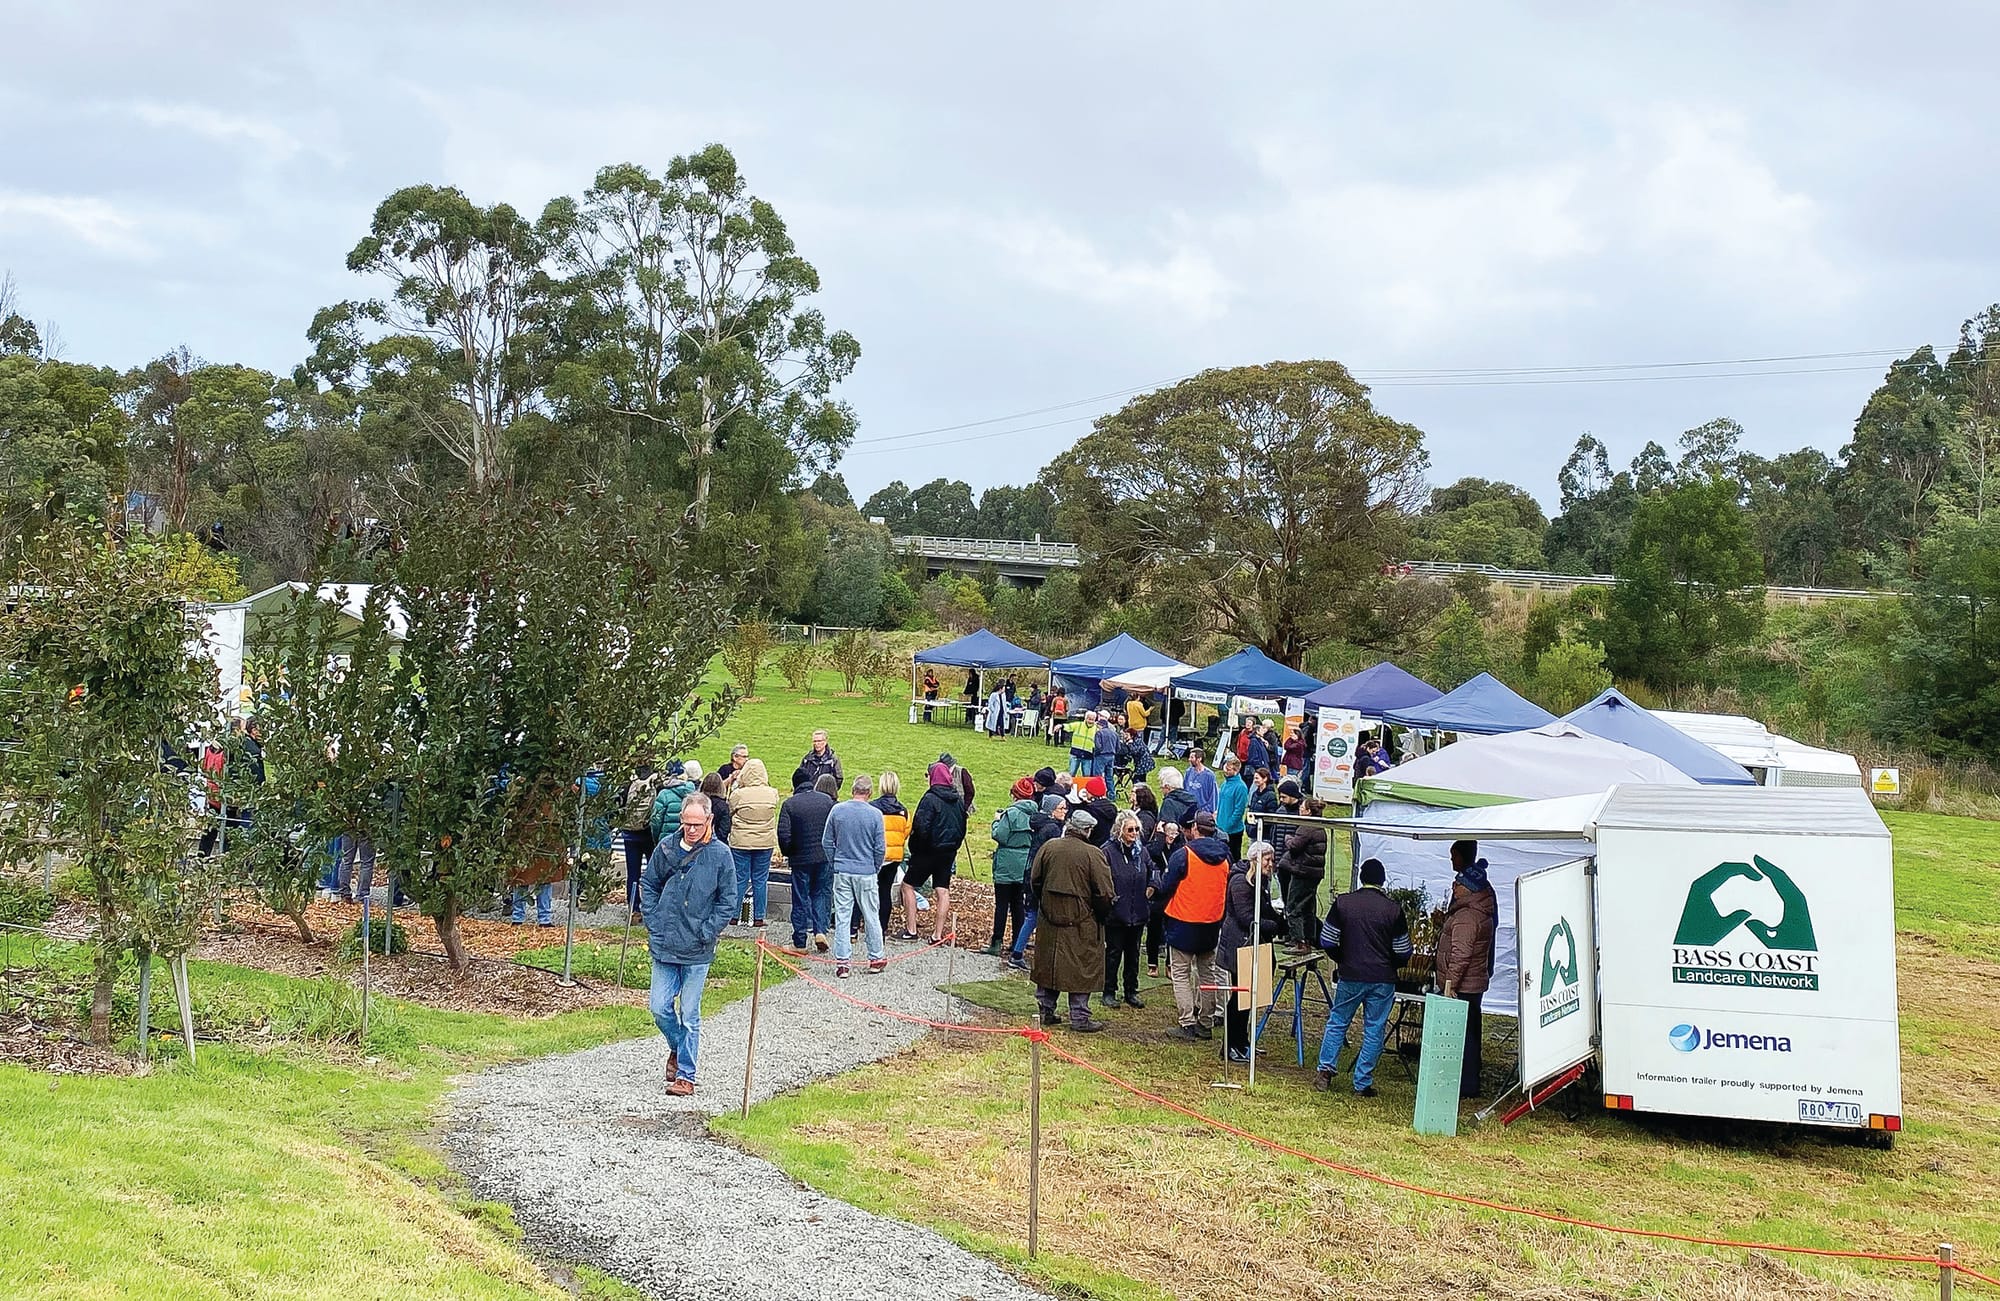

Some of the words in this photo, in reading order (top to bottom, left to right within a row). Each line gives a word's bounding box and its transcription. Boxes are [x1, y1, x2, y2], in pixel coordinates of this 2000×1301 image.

[1672, 948, 1732, 968] BASS
[1739, 951, 1819, 972] COAST
[1676, 968, 1746, 984] Landcare
[1751, 973, 1814, 988] Network
[1703, 1028, 1791, 1052] Jemena
[1636, 1072, 1688, 1083] Information
[1691, 1076, 1717, 1085] trailer
[1720, 1079, 1755, 1090] proudly
[1759, 1081, 1807, 1092] supported
[1810, 1084, 1822, 1095] by
[1827, 1086, 1863, 1096] Jemena
[1835, 1105, 1858, 1119] 710
